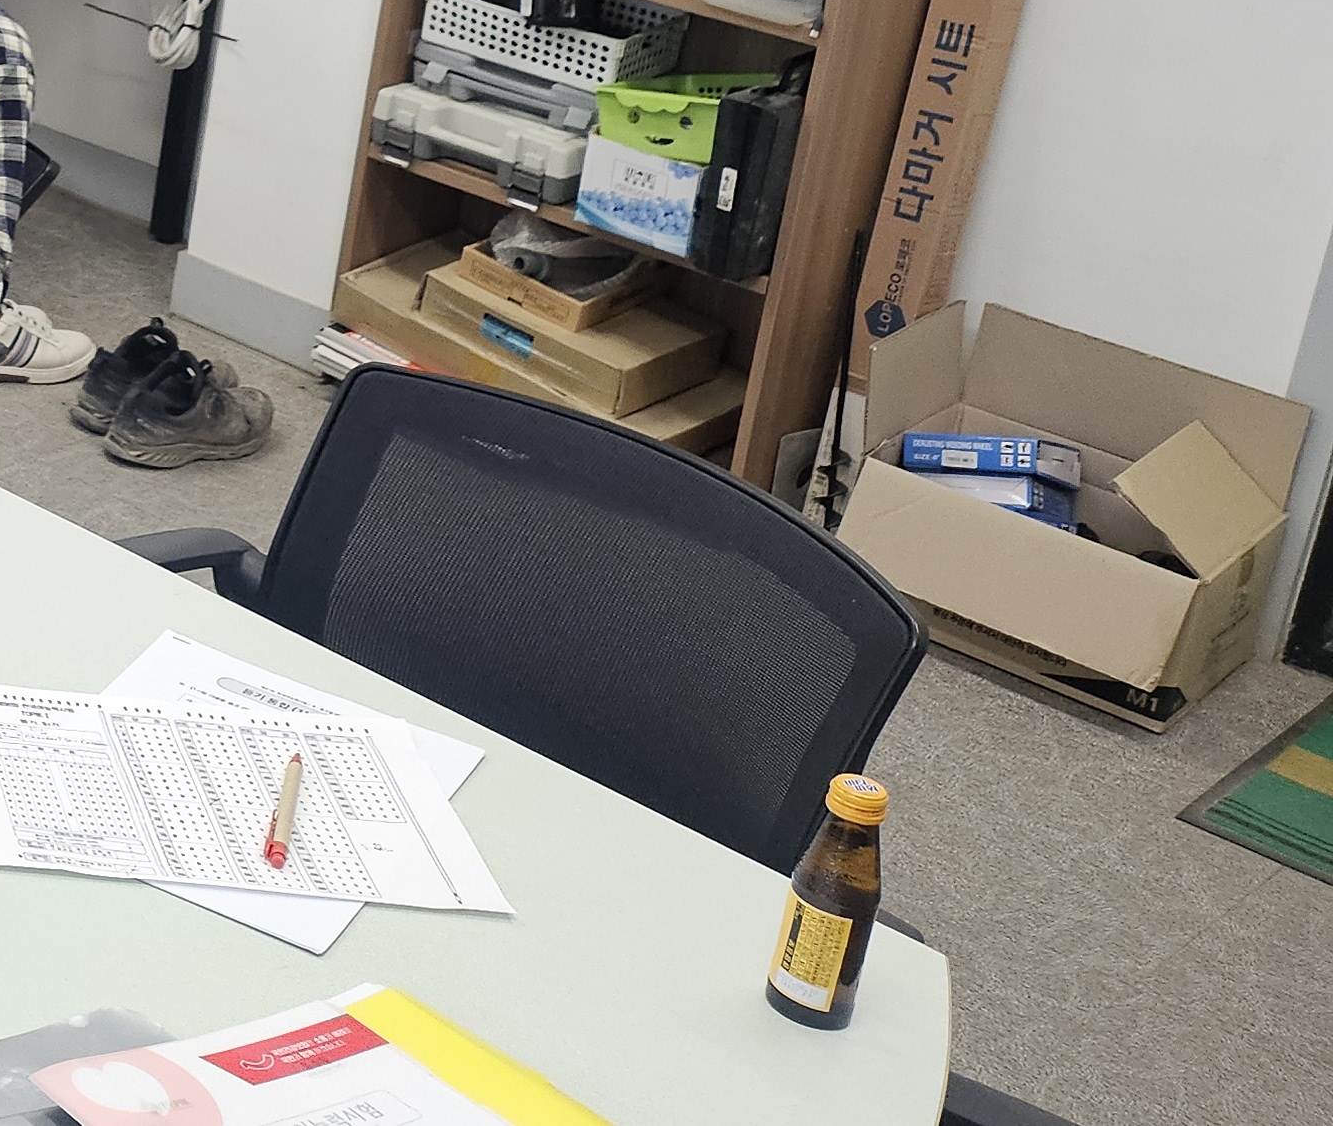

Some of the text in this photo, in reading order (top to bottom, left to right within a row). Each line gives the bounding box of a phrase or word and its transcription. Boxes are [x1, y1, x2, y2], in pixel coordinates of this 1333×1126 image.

[893, 19, 976, 223] 다마거 시트
[877, 273, 902, 333] LOPECO
[1125, 687, 1158, 712] M1
[293, 1102, 385, 1126] 력시험
